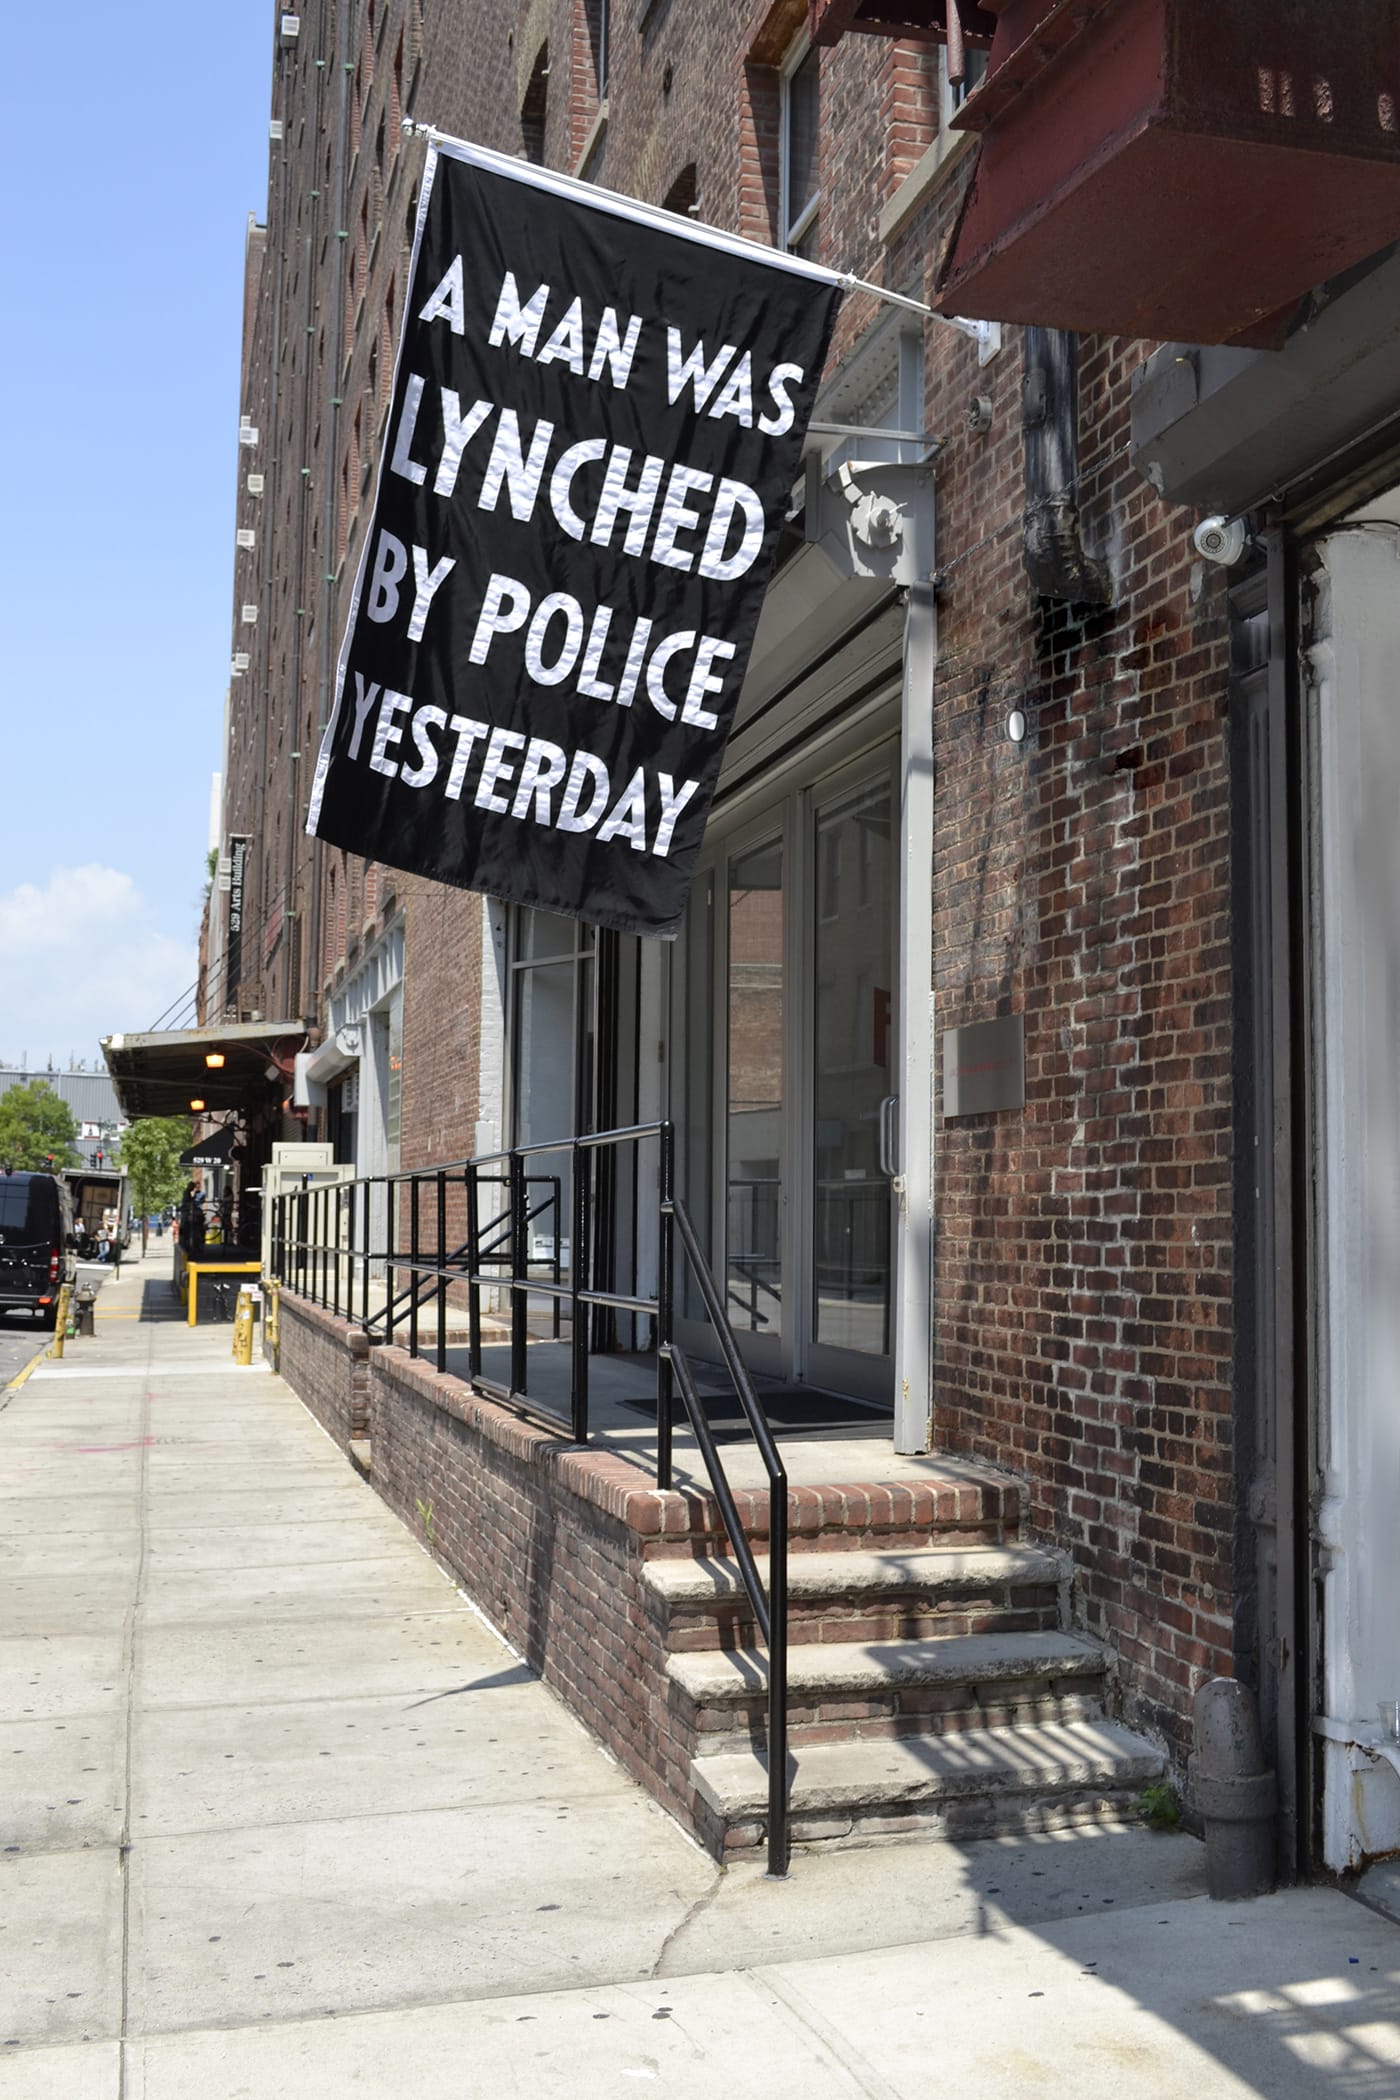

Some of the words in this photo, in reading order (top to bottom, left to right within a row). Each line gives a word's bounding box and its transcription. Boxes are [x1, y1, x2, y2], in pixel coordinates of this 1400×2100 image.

[418, 254, 465, 336] A
[487, 271, 643, 389] MAN
[667, 326, 804, 437] WAS
[391, 373, 765, 581] LYNCHED
[367, 528, 457, 643] BY
[468, 572, 737, 731] POLICE
[346, 671, 700, 858] YESTERDAY
[230, 888, 242, 911] Arts
[230, 912, 241, 931] 529
[231, 843, 246, 885] Building
